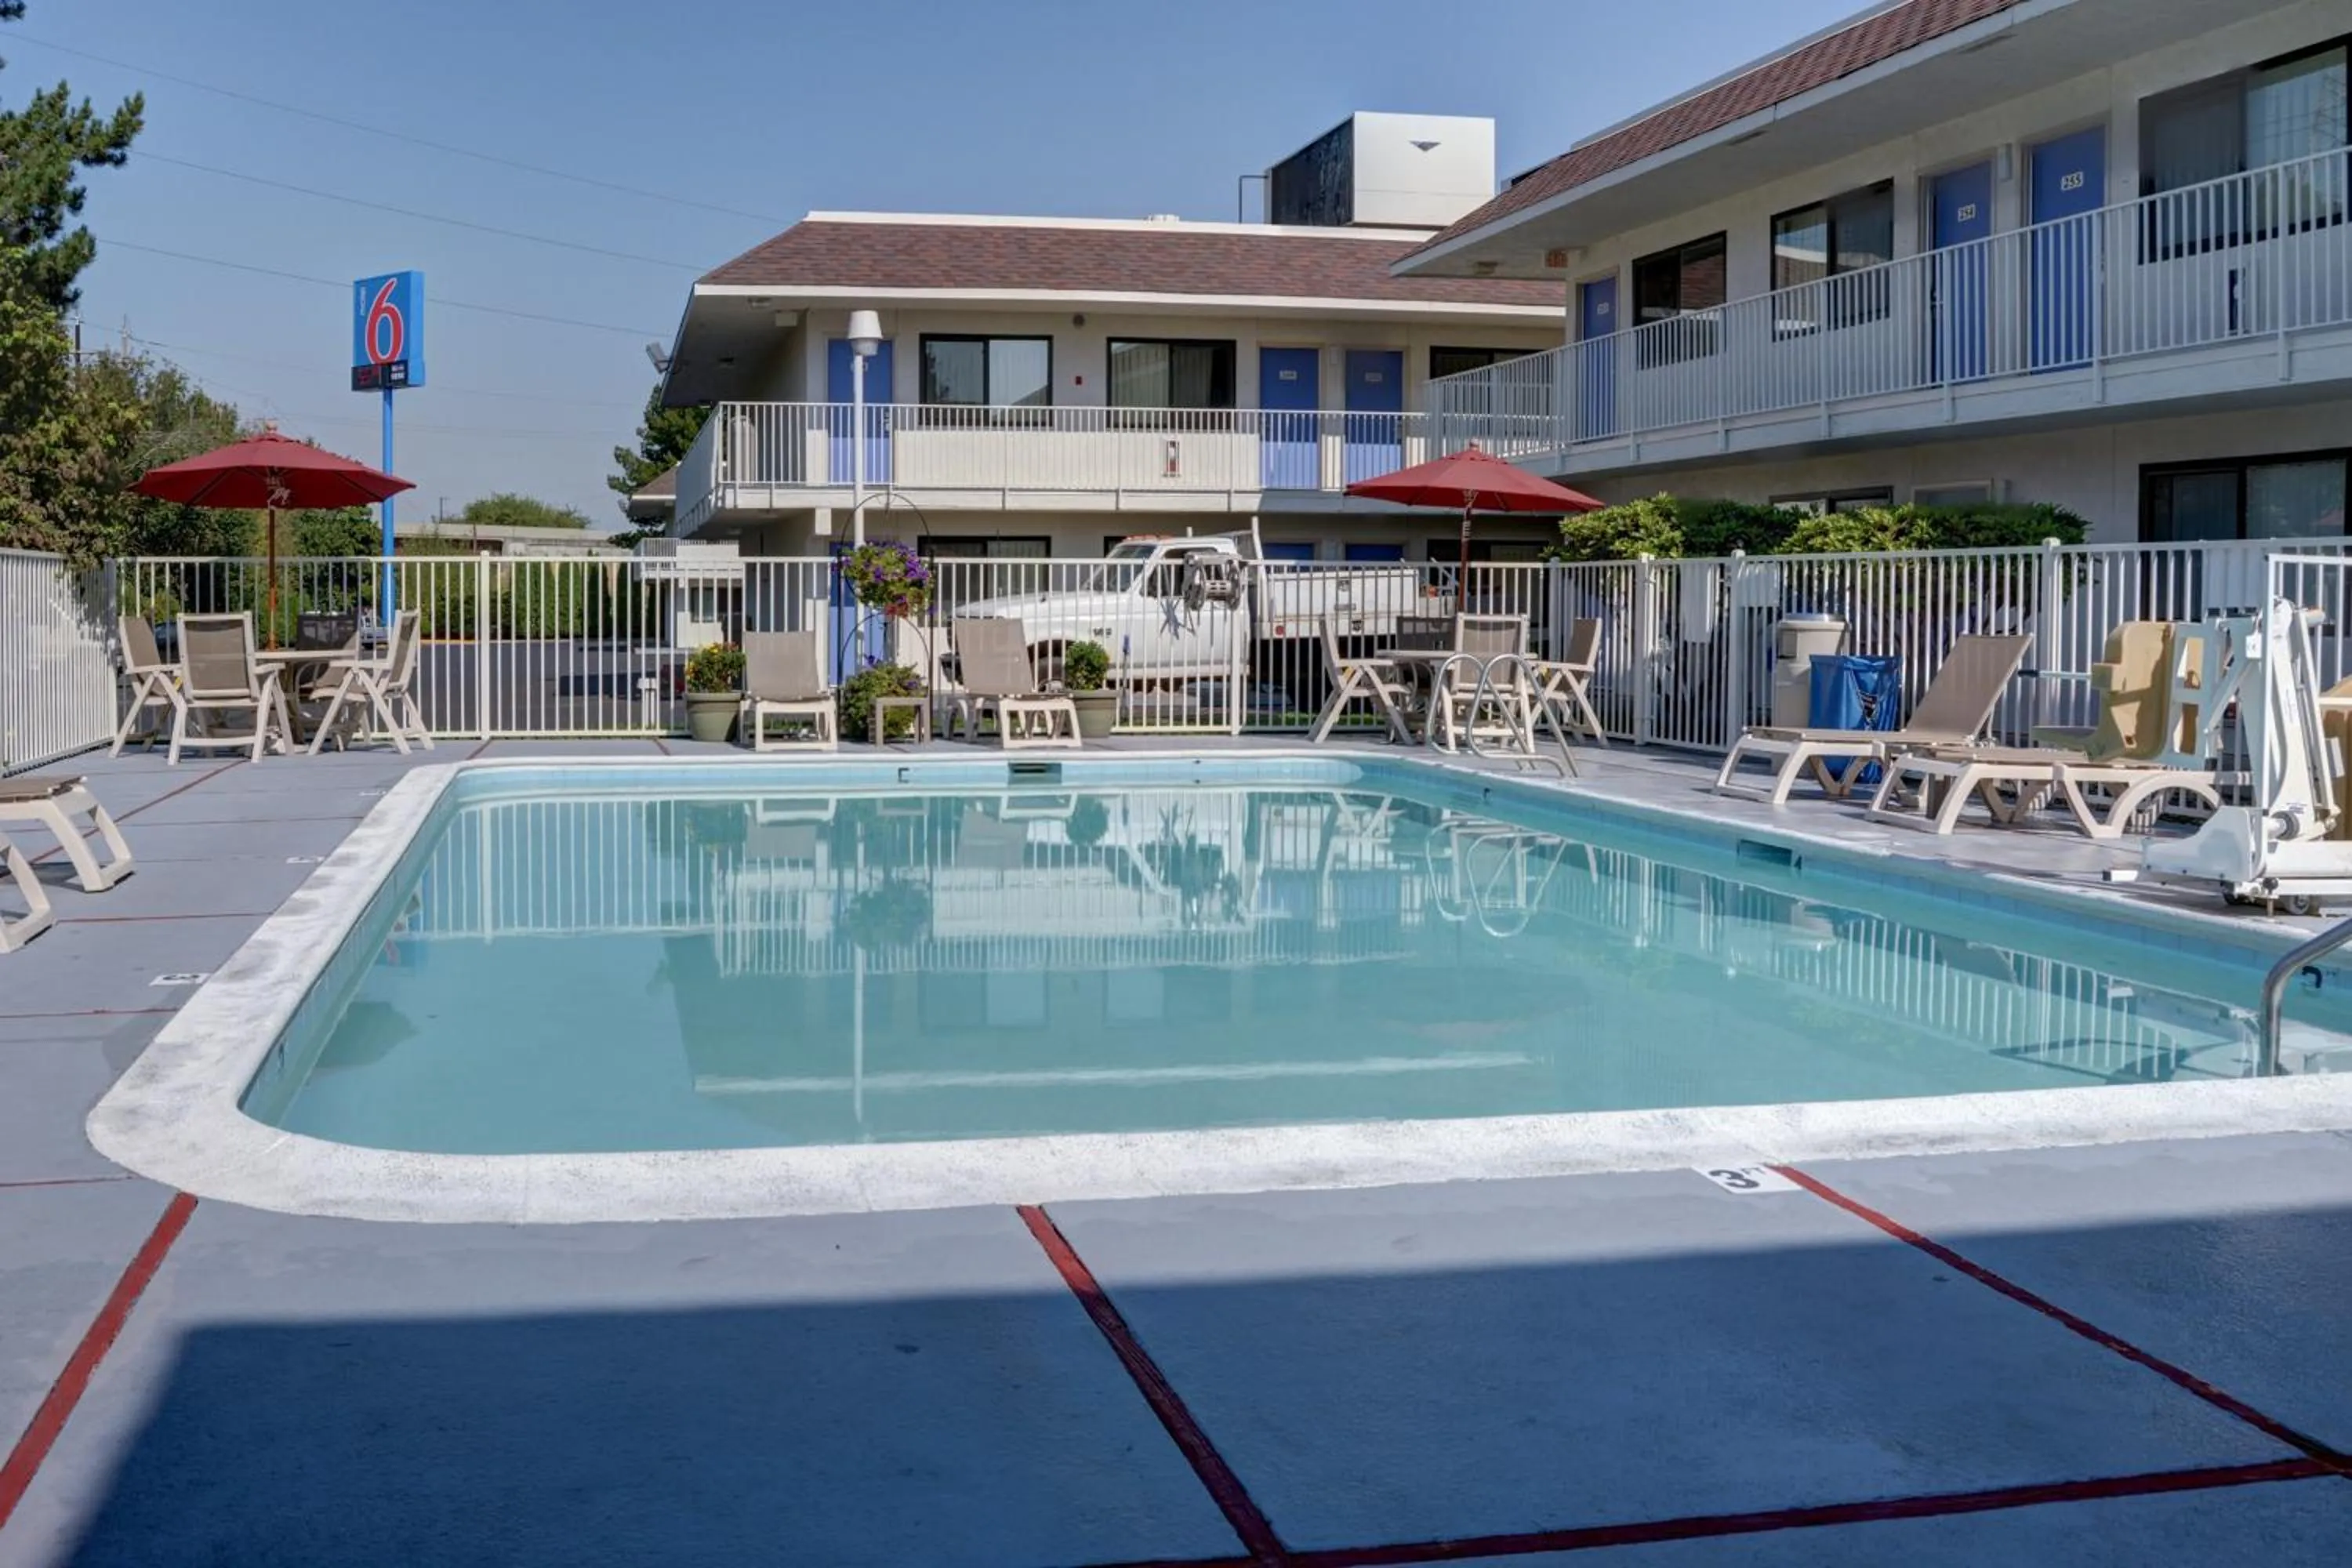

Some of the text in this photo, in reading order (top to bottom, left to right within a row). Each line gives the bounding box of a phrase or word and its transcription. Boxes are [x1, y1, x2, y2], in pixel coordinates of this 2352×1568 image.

[2063, 172, 2082, 190] 255
[365, 277, 404, 364] 6
[1709, 1169, 1760, 1189] 3
